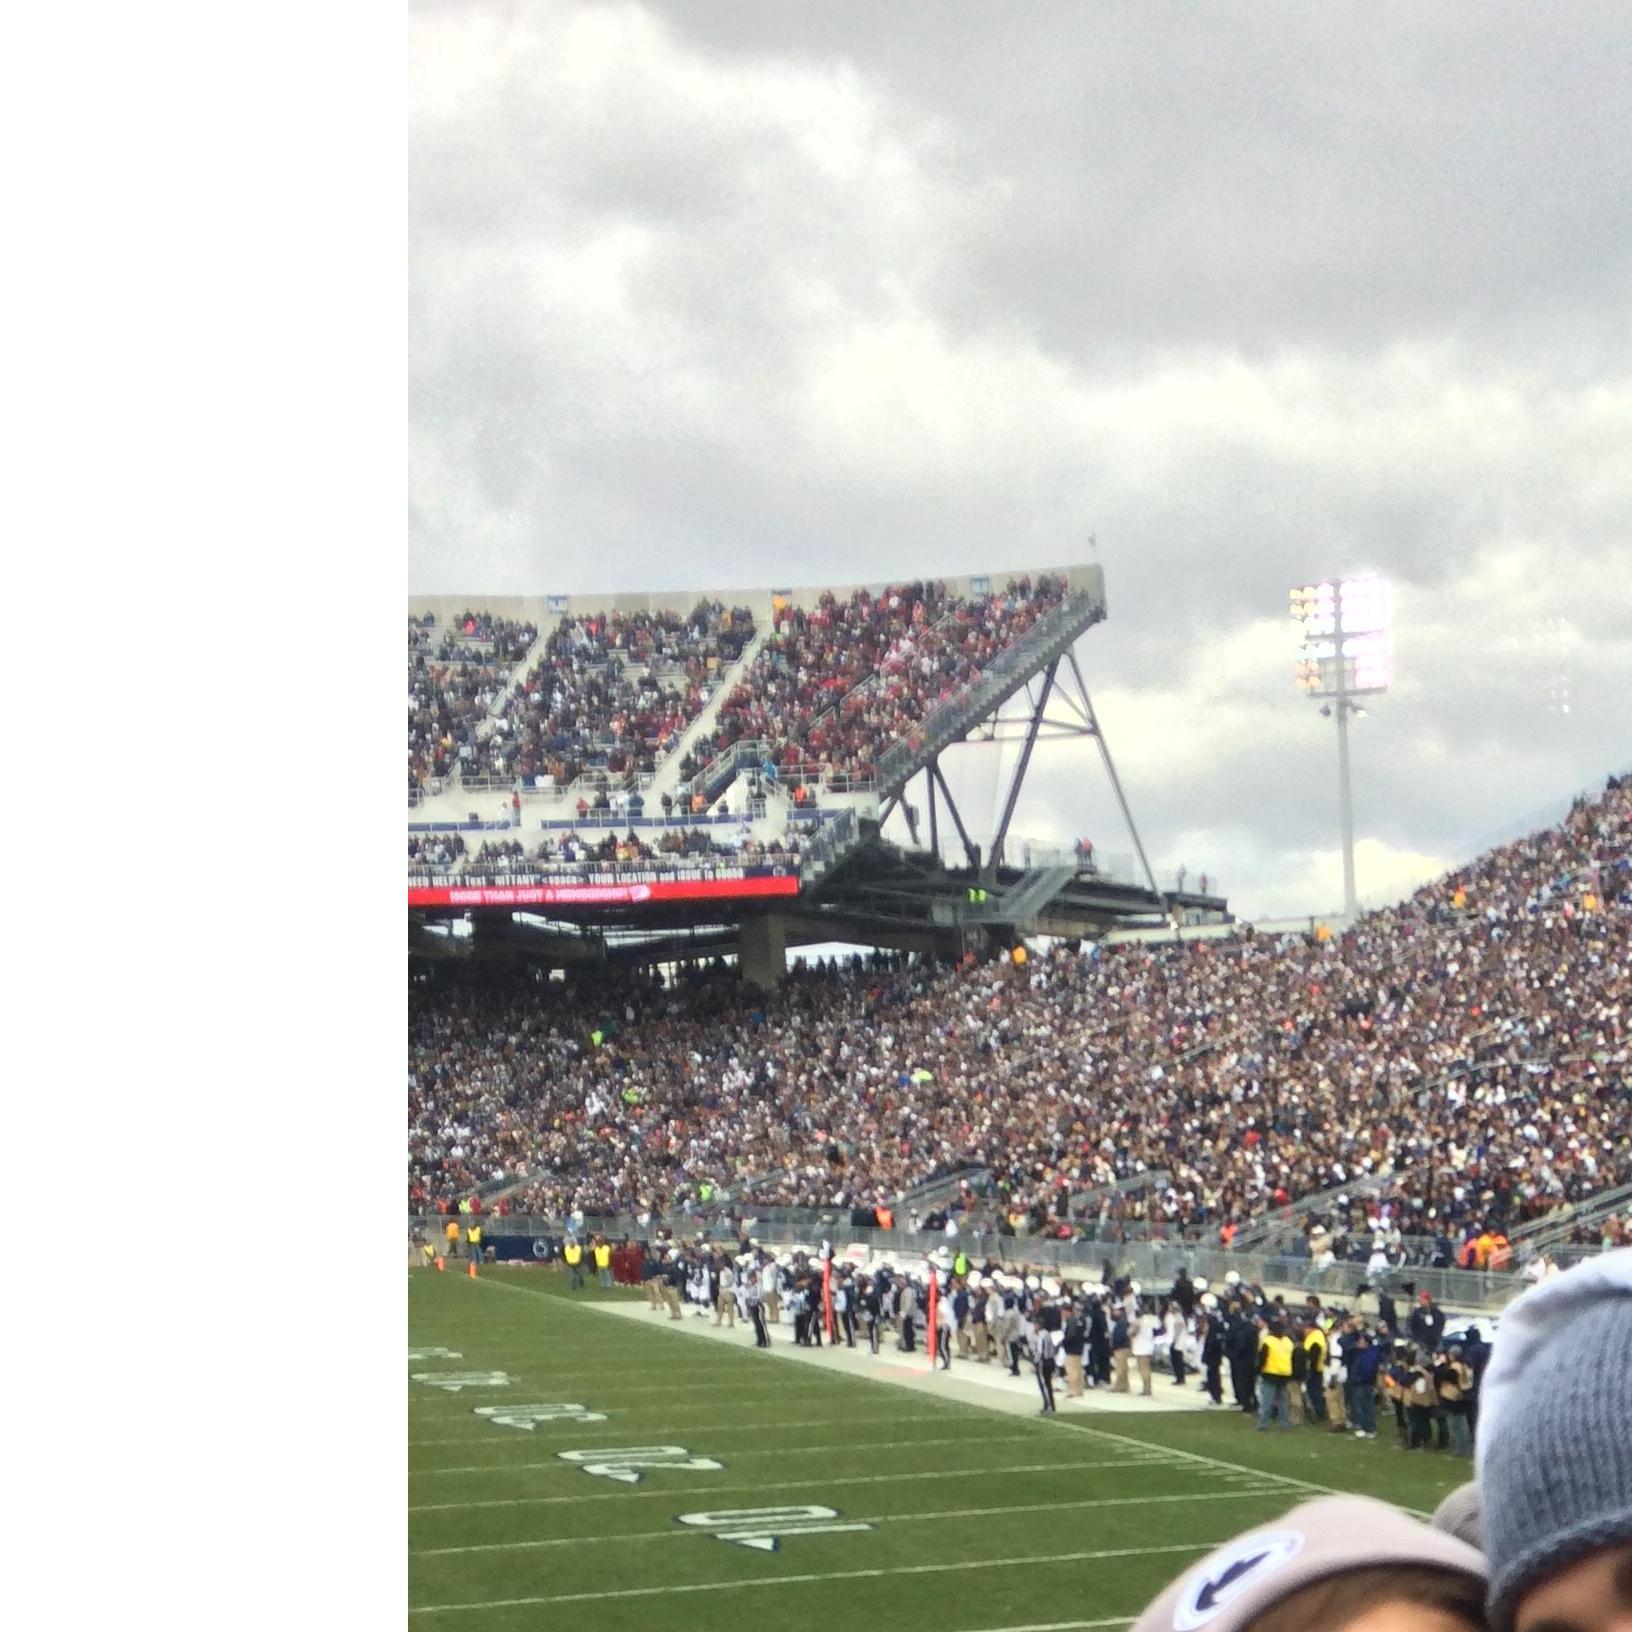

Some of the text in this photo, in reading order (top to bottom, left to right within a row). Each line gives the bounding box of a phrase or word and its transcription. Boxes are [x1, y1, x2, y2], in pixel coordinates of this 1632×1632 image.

[588, 873, 614, 885] YOUR
[616, 872, 657, 884] LOCATION
[483, 889, 514, 903] THAN
